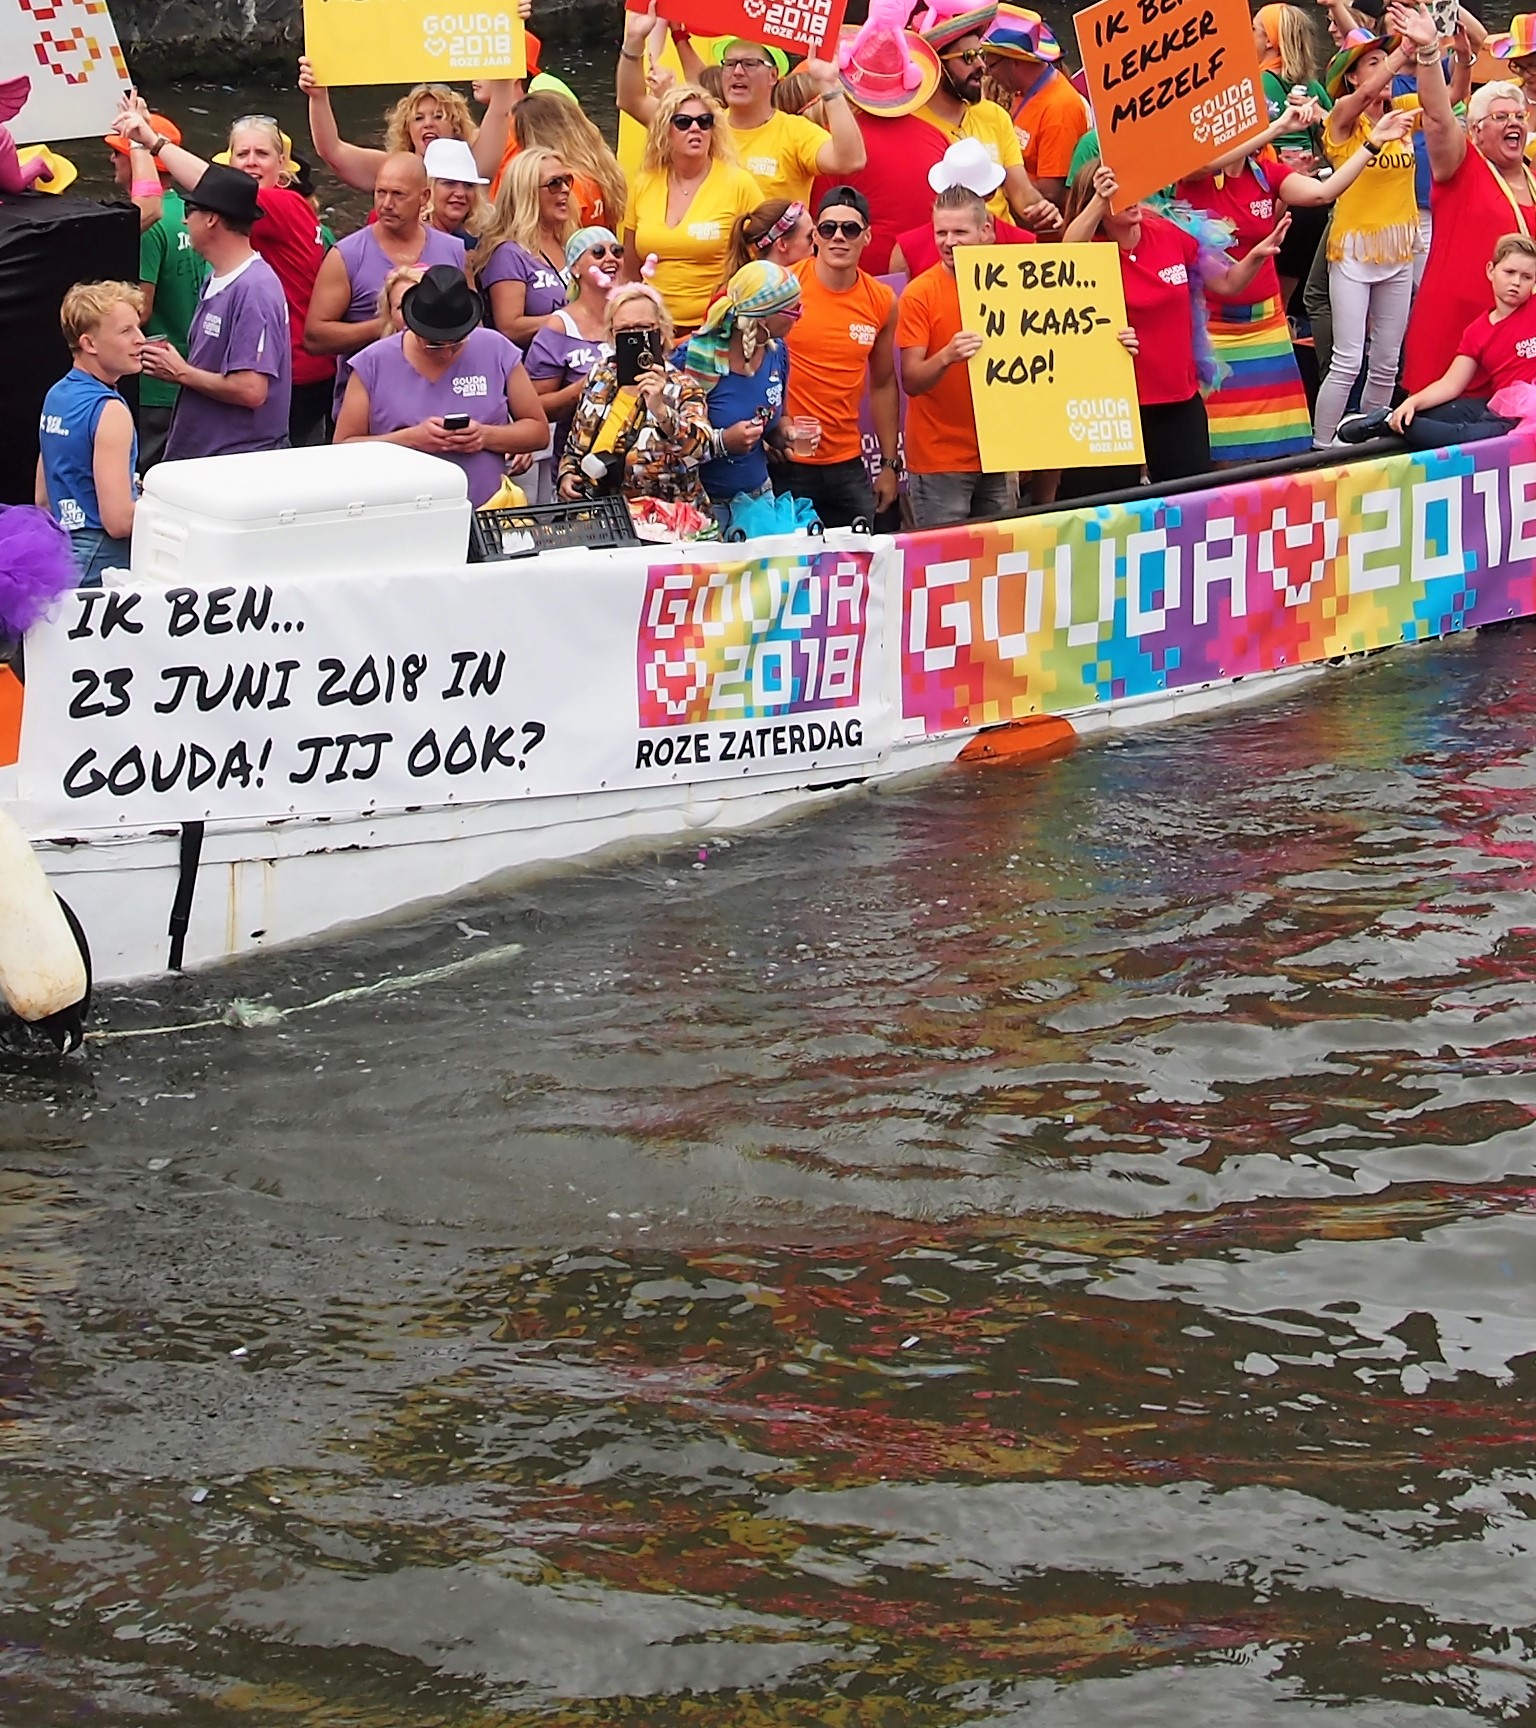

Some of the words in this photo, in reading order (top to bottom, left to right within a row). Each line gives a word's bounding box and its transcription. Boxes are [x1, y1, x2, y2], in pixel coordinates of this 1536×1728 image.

[423, 12, 510, 35] GOUDA
[763, 22, 794, 40] ROZE
[793, 30, 823, 47] JAAR
[765, 3, 828, 36] 2018
[1095, 10, 1129, 48] IK
[448, 34, 511, 55] 2018
[1102, 9, 1218, 91] LEKKER
[450, 57, 480, 68] ROZE
[482, 56, 511, 67] JAAR
[1110, 47, 1226, 134] MEZELF
[1190, 77, 1253, 126] GOUDA
[1210, 96, 1256, 136] 2018
[1214, 128, 1236, 147] ROZE
[1237, 115, 1258, 135] JAAR
[1366, 153, 1414, 170] GOUD
[974, 262, 1008, 291] IK
[1018, 260, 1096, 289] BEN...
[1020, 306, 1111, 336] KAAS-
[566, 348, 595, 369] IK
[986, 348, 1054, 386] KOP!
[452, 375, 486, 386] GOUDA
[1066, 398, 1130, 419] GOUDA
[1087, 421, 1132, 441] 2018
[1090, 442, 1112, 453] ROZE
[1114, 441, 1134, 452] JAAR
[647, 561, 864, 639] GOUDA
[909, 517, 1247, 672] GOUDA
[67, 590, 144, 640] IK
[164, 584, 305, 638] BEN...
[68, 666, 134, 719] 23
[154, 659, 301, 715] JUNI
[317, 653, 427, 707] 2018
[442, 649, 506, 700] IN
[708, 634, 859, 712] 2018
[62, 737, 273, 799] GOUDA!
[289, 732, 394, 786] JIJ
[407, 721, 547, 779] OOK?
[635, 732, 711, 770] ROZE
[718, 718, 863, 762] ZATERDAG
